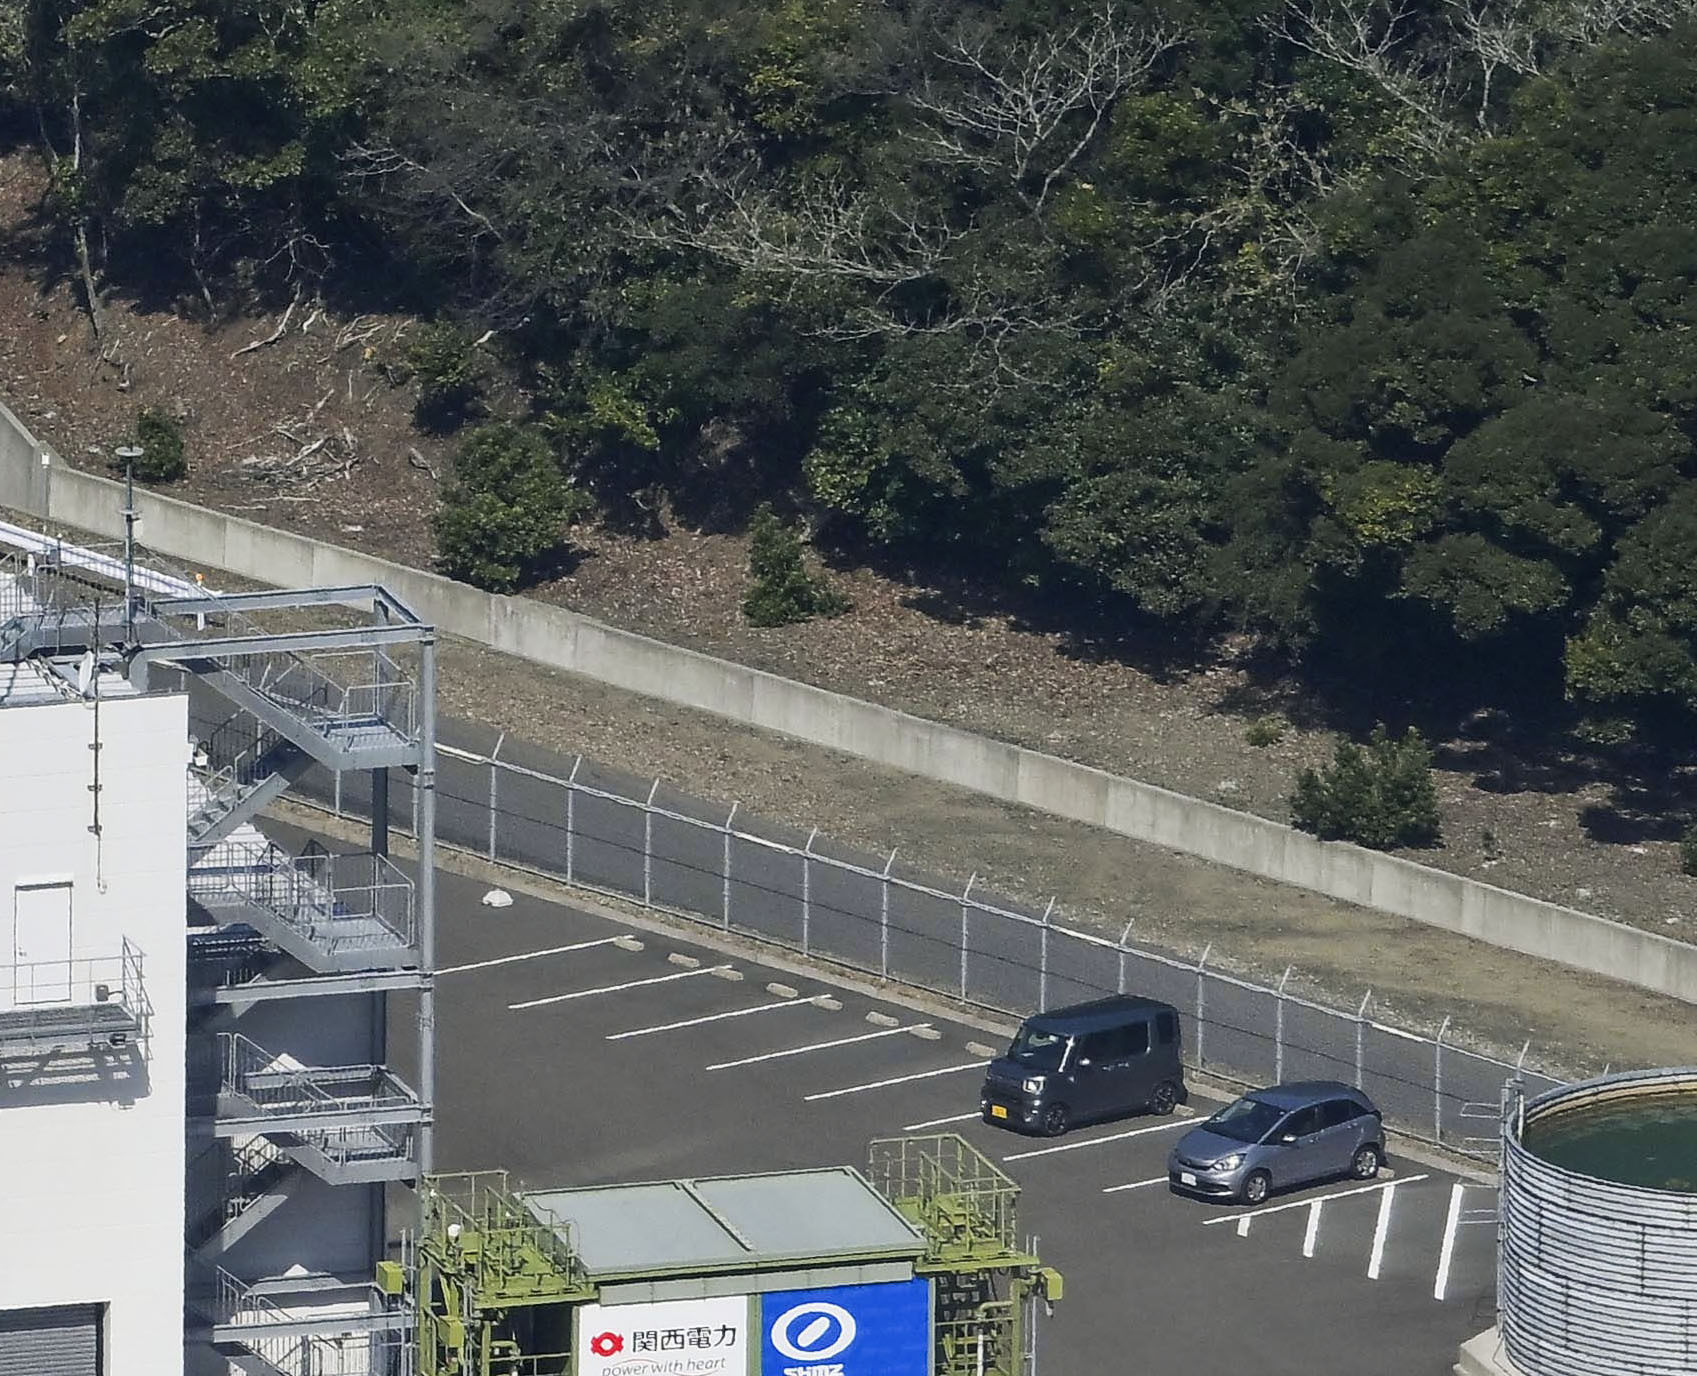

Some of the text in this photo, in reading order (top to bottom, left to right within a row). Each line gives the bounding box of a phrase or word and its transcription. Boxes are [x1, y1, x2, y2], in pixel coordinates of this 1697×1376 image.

[632, 1324, 737, 1353] 関西電力
[651, 1359, 683, 1373] with
[687, 1357, 726, 1371] heart
